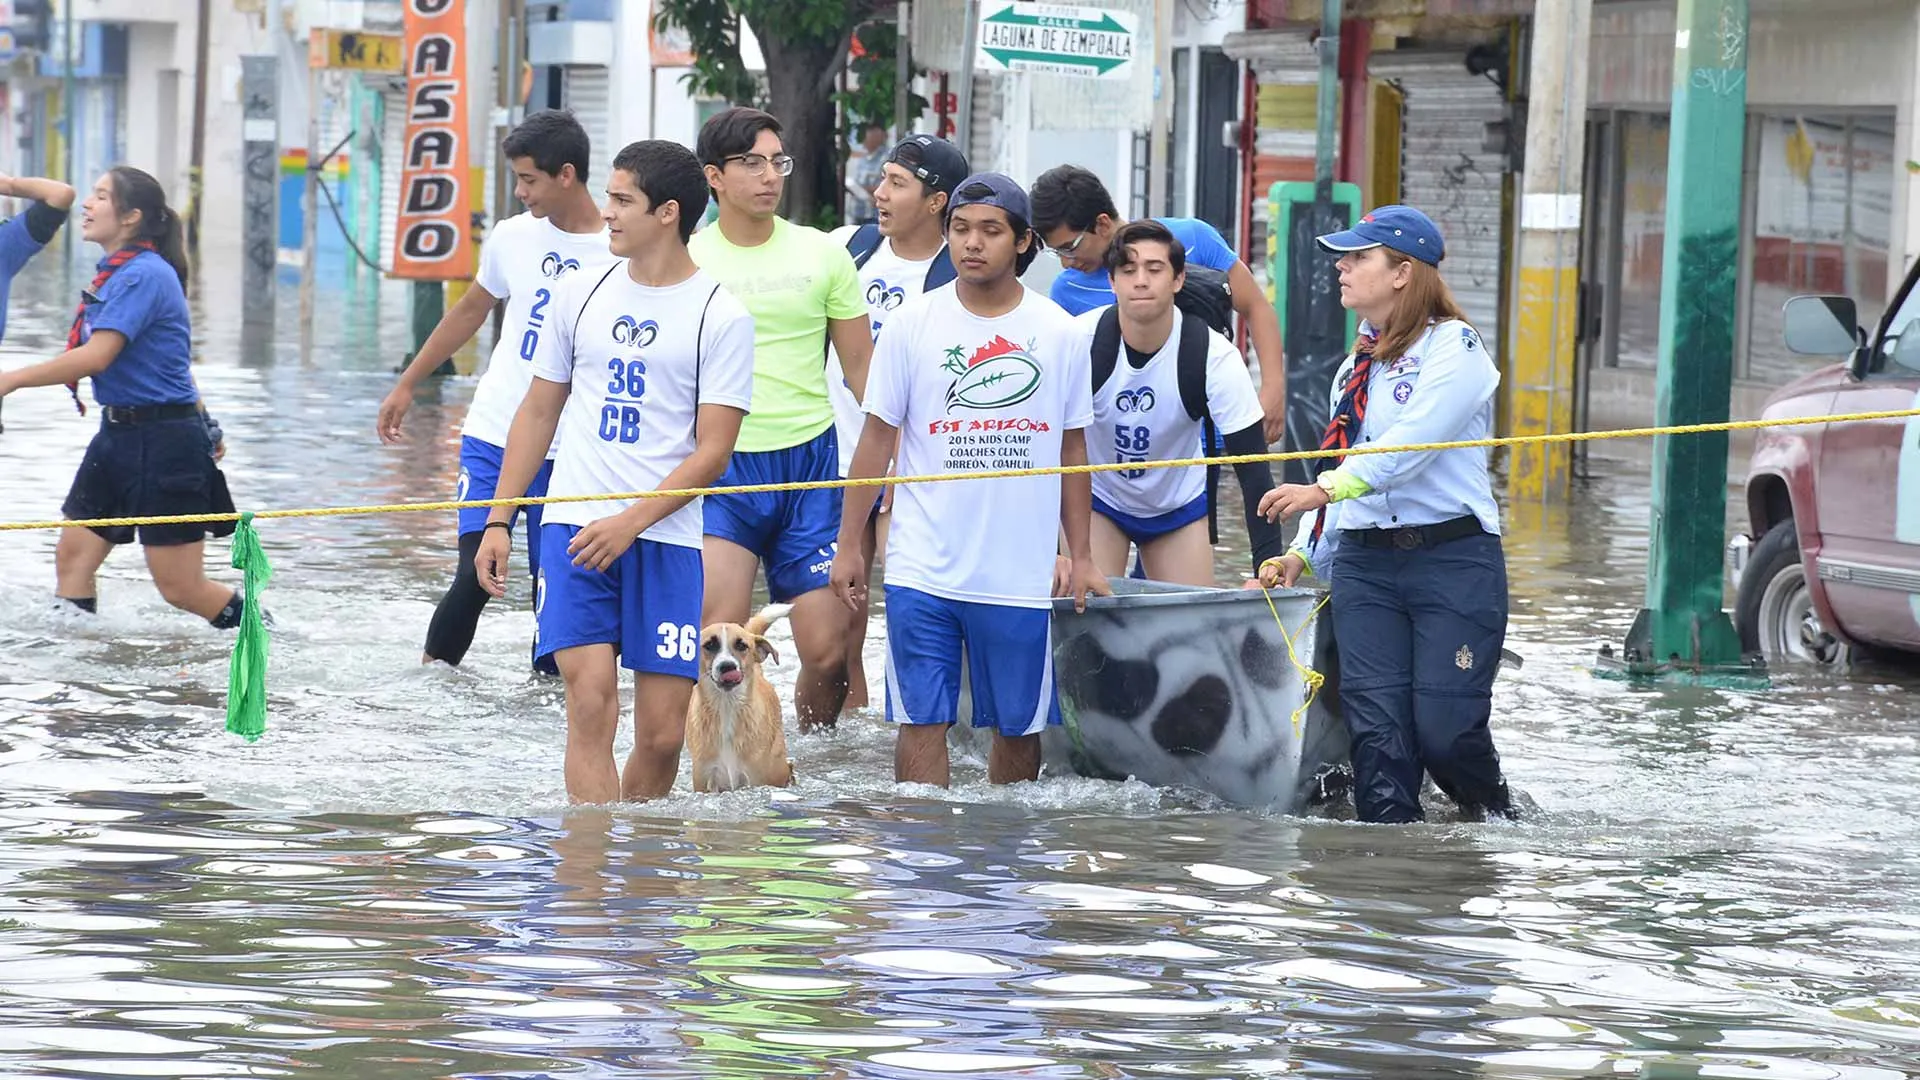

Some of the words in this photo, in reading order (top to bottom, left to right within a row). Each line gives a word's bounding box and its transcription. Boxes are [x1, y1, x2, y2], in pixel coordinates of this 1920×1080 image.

[1038, 17, 1080, 29] CALLE
[983, 23, 1035, 49] LAGUNA
[1041, 29, 1057, 51] DE
[1062, 30, 1131, 57] ZEMPOALA
[401, 34, 459, 262] ASADO
[607, 357, 647, 398] 36
[598, 404, 641, 444] CB
[967, 418, 1050, 432] ARIZONA
[1115, 424, 1150, 451] 58
[948, 435, 976, 445] 2018
[978, 435, 1001, 445] KIDS
[1004, 435, 1031, 445] CAMP
[949, 447, 996, 457] COACHES
[998, 447, 1029, 457] CLINIC
[992, 459, 1033, 470] COAHUIL
[656, 621, 697, 662] 36
